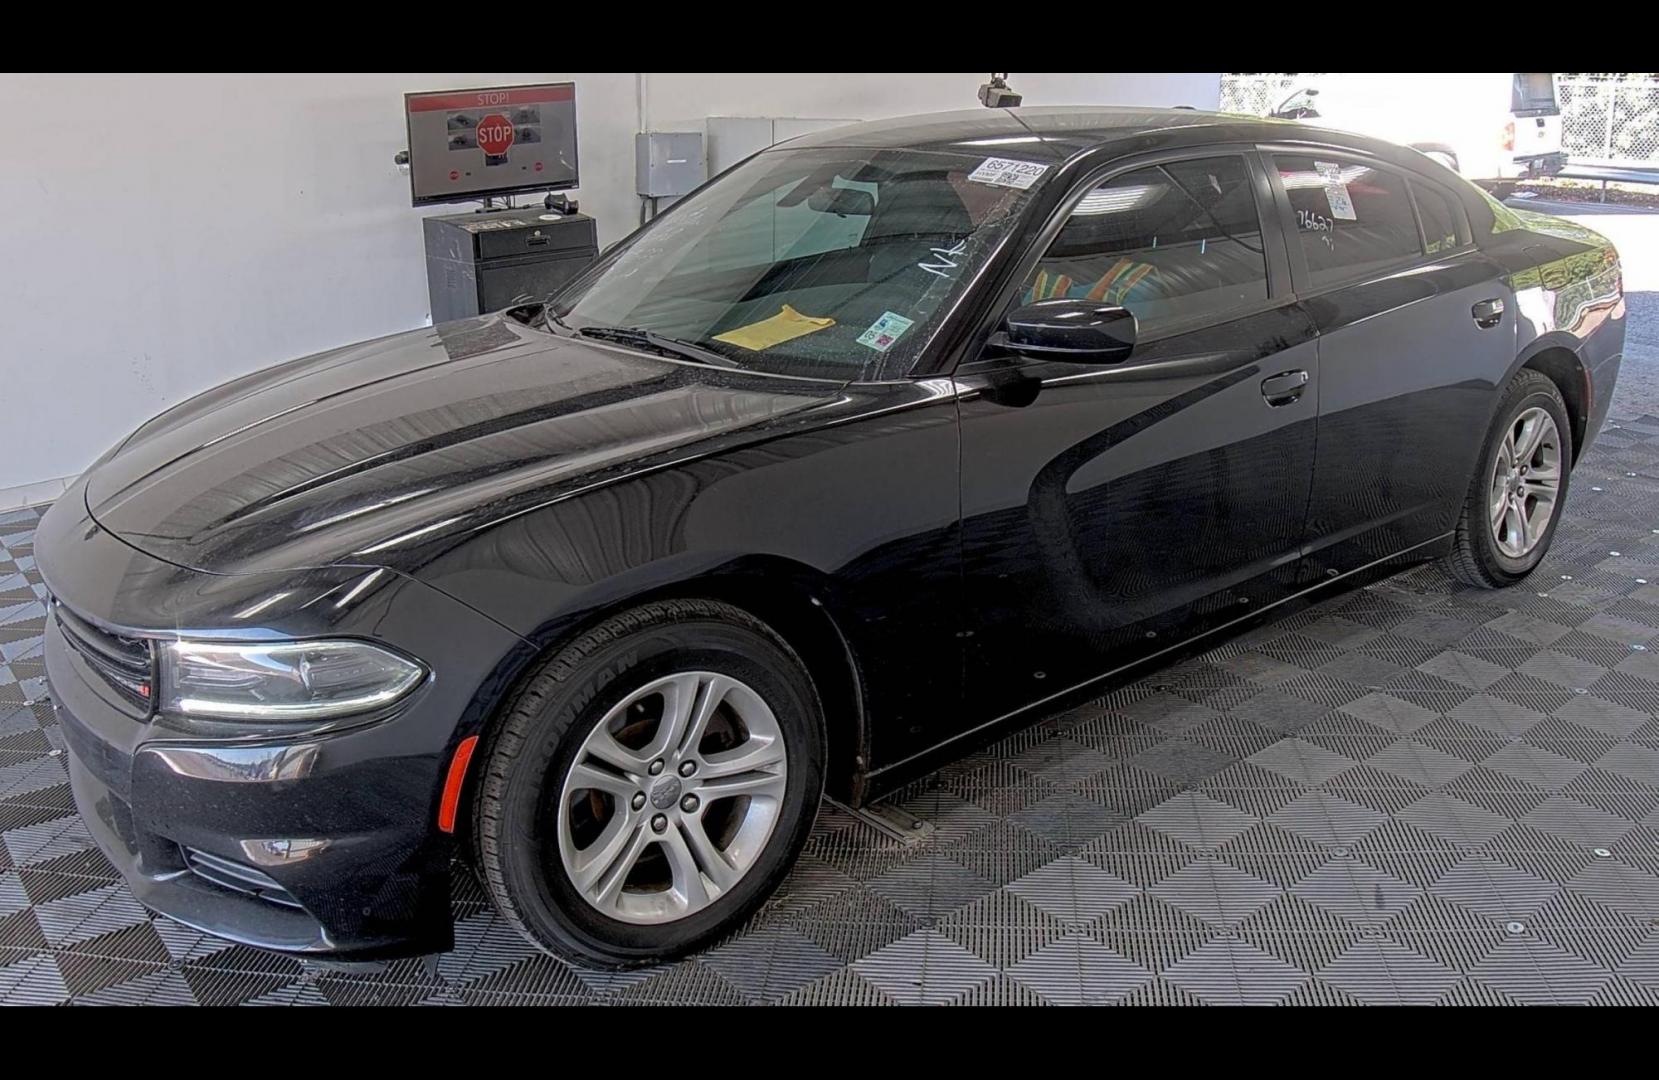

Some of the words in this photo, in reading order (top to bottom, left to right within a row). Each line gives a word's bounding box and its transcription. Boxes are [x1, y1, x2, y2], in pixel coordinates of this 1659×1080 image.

[478, 92, 510, 106] STOP!
[479, 126, 512, 144] STOP
[987, 160, 1045, 177] 6571220
